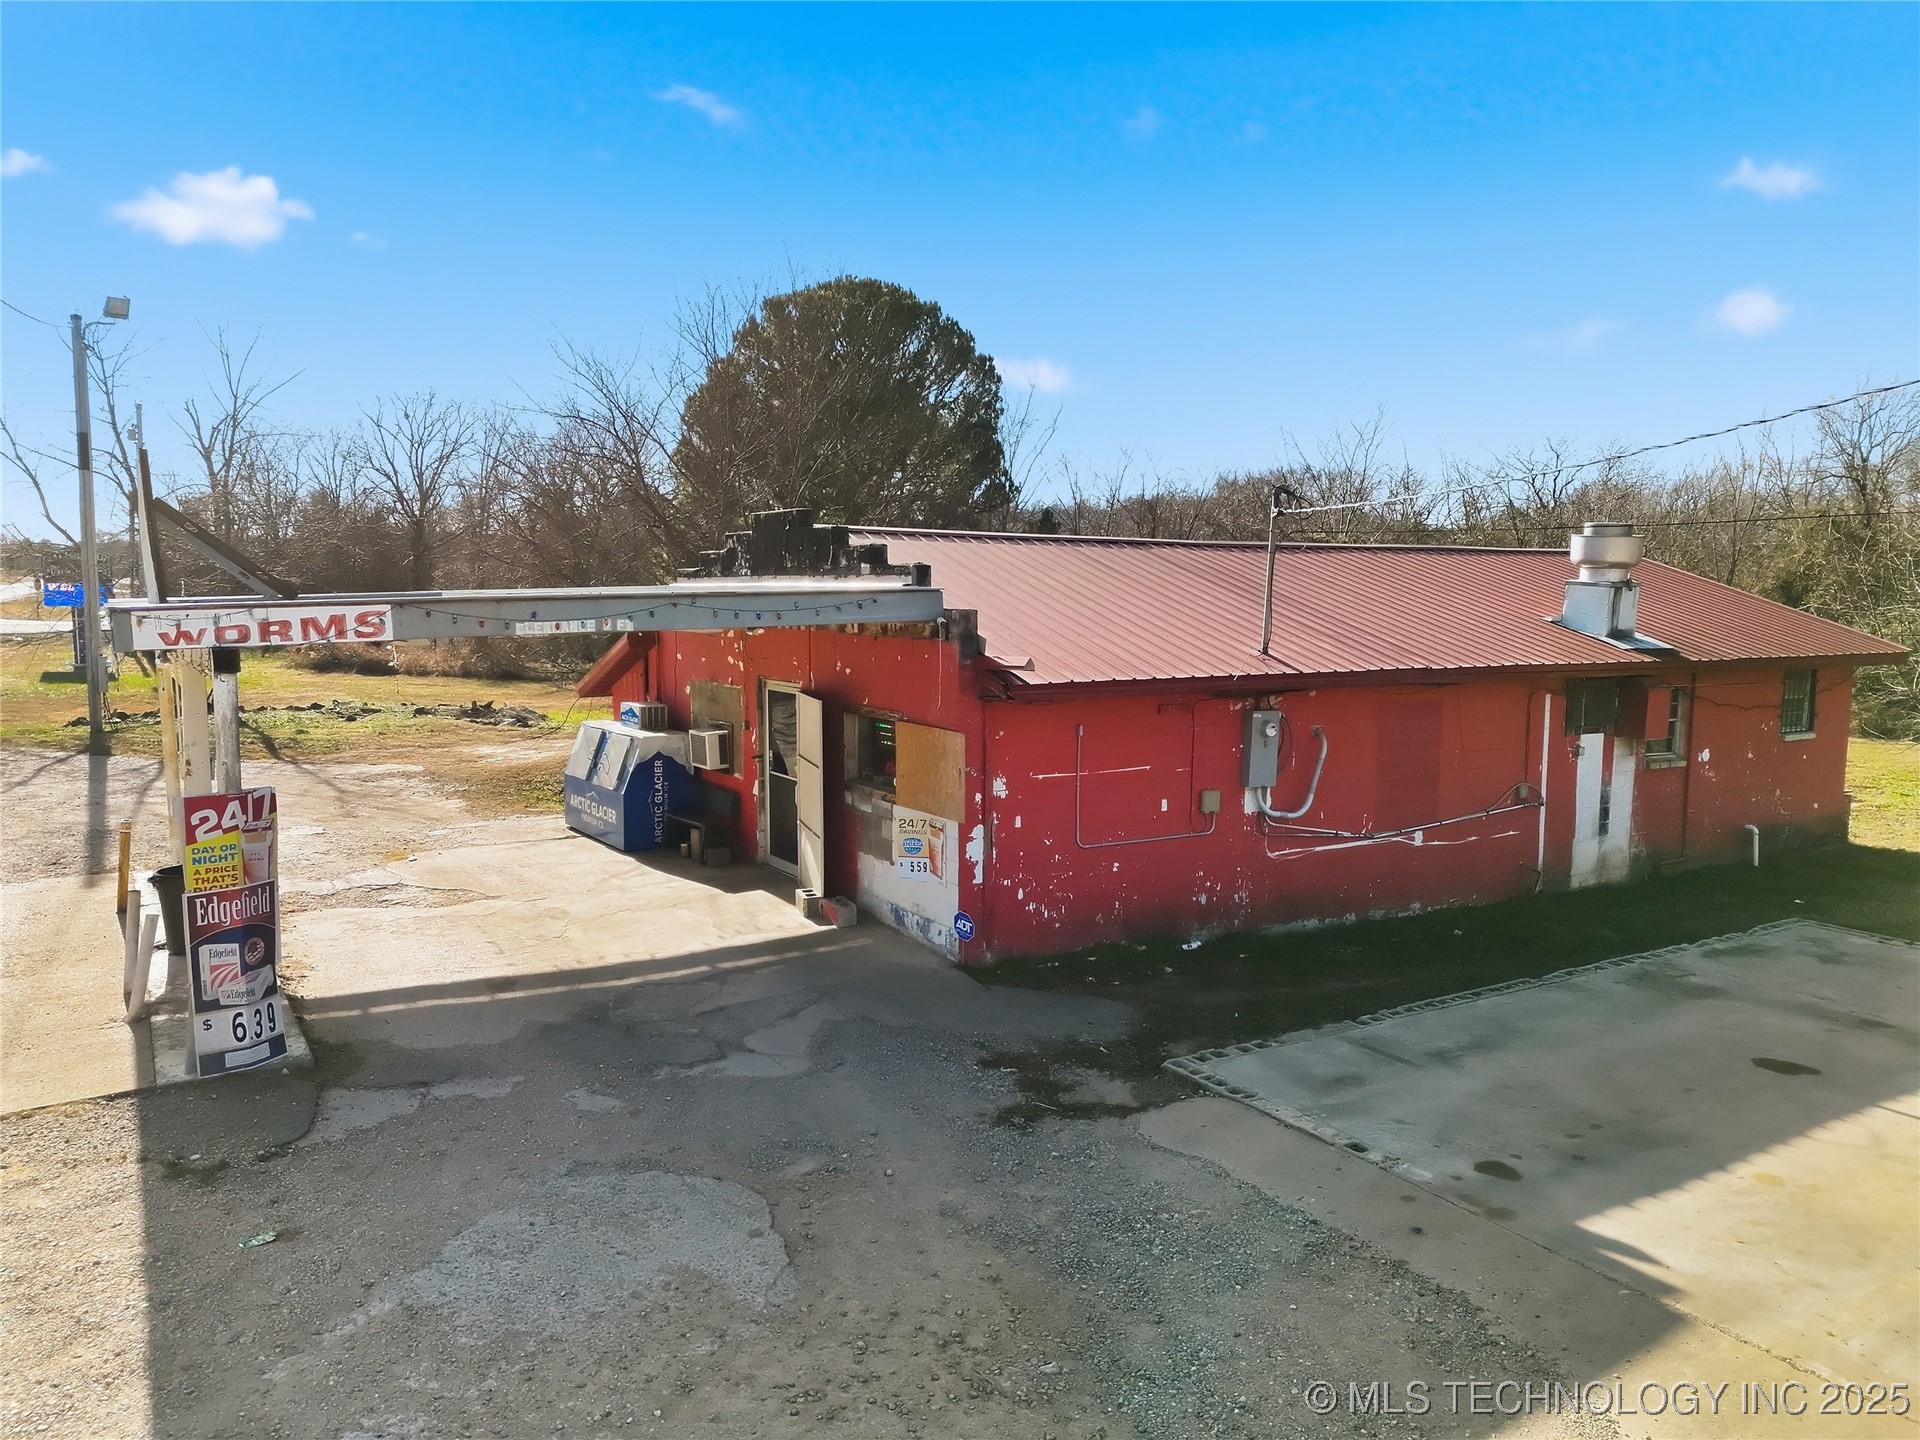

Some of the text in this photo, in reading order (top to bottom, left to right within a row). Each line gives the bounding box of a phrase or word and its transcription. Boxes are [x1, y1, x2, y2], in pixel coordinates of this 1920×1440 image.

[157, 610, 388, 647] WORMS
[654, 760, 663, 843] ARCTIC GLACIER
[570, 794, 617, 824] ARCTIC GLACIER
[899, 818, 927, 829] 24/7
[191, 843, 237, 856] DAY OR
[191, 852, 238, 866] NIGHT
[193, 865, 238, 876] A PRICE
[193, 873, 239, 886] THAT'S
[194, 885, 271, 927] Edgefield
[956, 918, 973, 933] ADT
[209, 948, 237, 959] Edgefield
[230, 987, 256, 1000] Edgefield
[202, 1002, 276, 1043] $ 6.39
